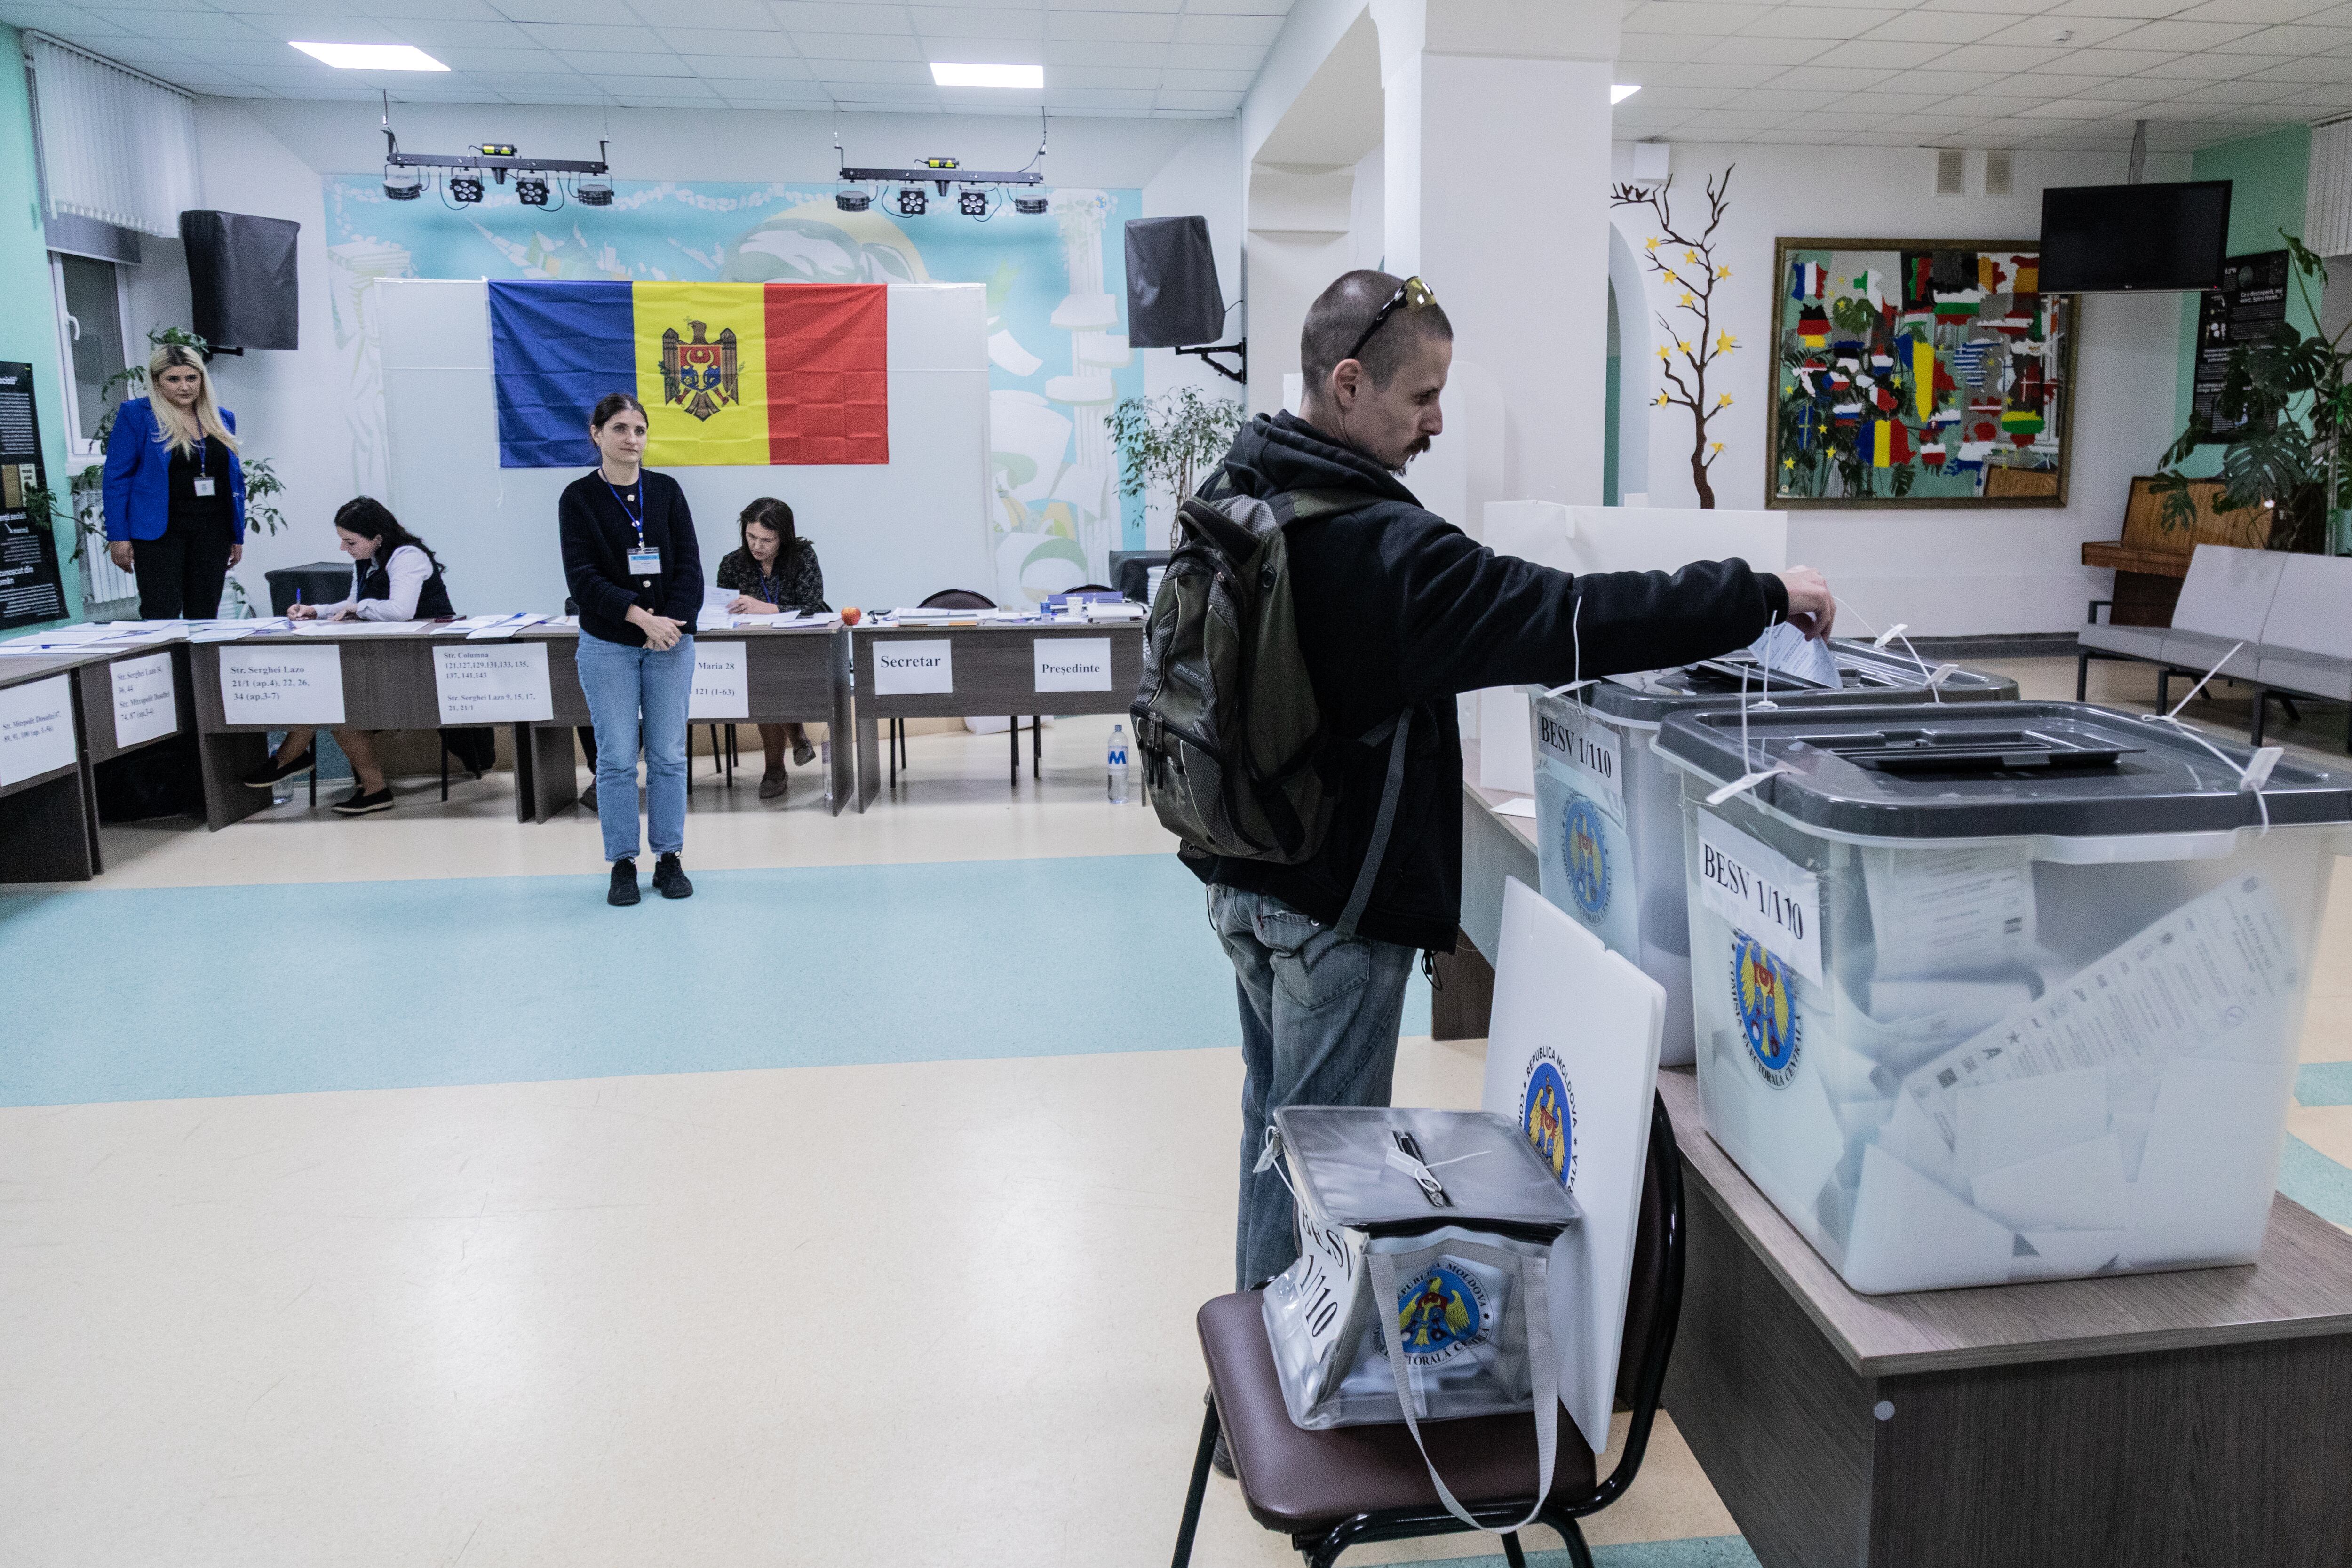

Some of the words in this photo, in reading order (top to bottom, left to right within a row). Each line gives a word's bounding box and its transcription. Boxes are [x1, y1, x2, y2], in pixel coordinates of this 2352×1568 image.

[881, 655, 941, 668] Secretar
[248, 666, 281, 675] Serghei
[1176, 664, 1190, 674] ONE
[253, 679, 280, 688] (ap.4),
[246, 692, 280, 701] (ap.3-7)
[1541, 716, 1575, 756] BESV
[1579, 738, 1611, 778] 1/110
[1704, 843, 1750, 901] BESV
[1757, 880, 1803, 939] 1/110
[1526, 1046, 1556, 1078] REPUBLICA
[1557, 1055, 1577, 1129] MOLDOVA
[1447, 1263, 1487, 1307] MOLDOVA
